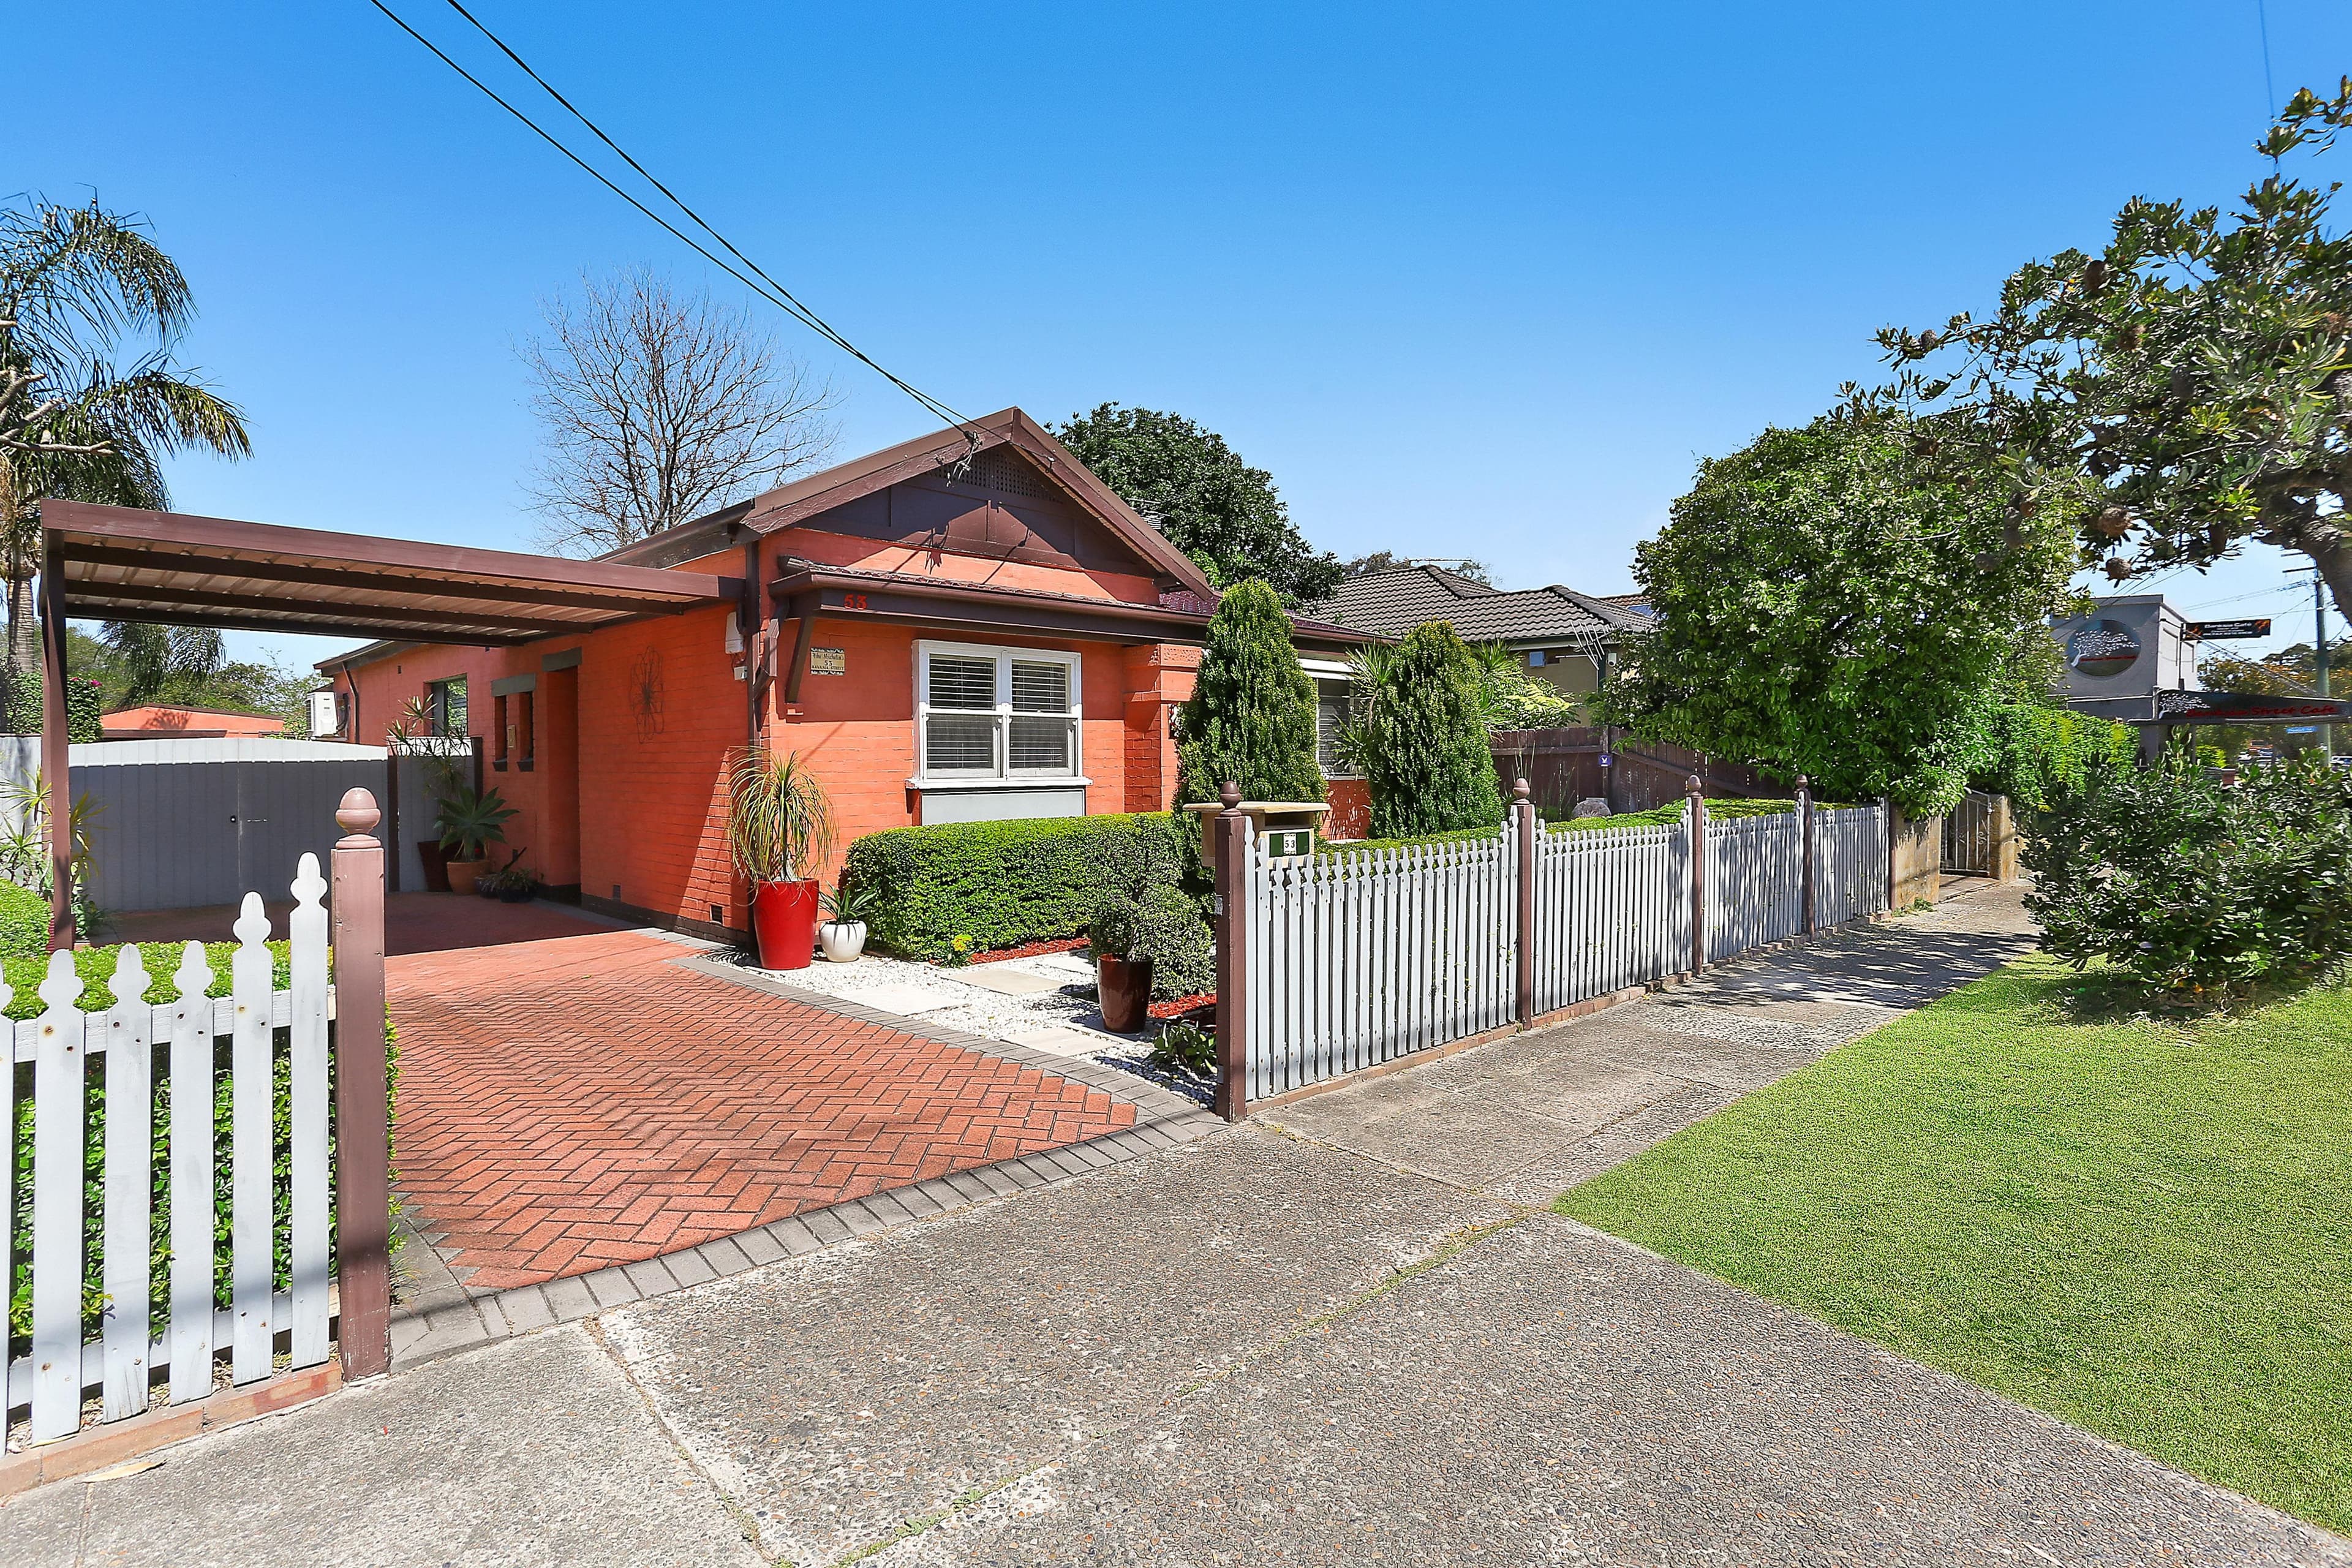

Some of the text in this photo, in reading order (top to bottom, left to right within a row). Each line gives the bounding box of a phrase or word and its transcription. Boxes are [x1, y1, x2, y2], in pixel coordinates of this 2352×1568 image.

[843, 594, 867, 610] 53
[2251, 706, 2295, 716] Street
[2301, 705, 2338, 715] Cafe
[1285, 840, 1295, 848] 53
